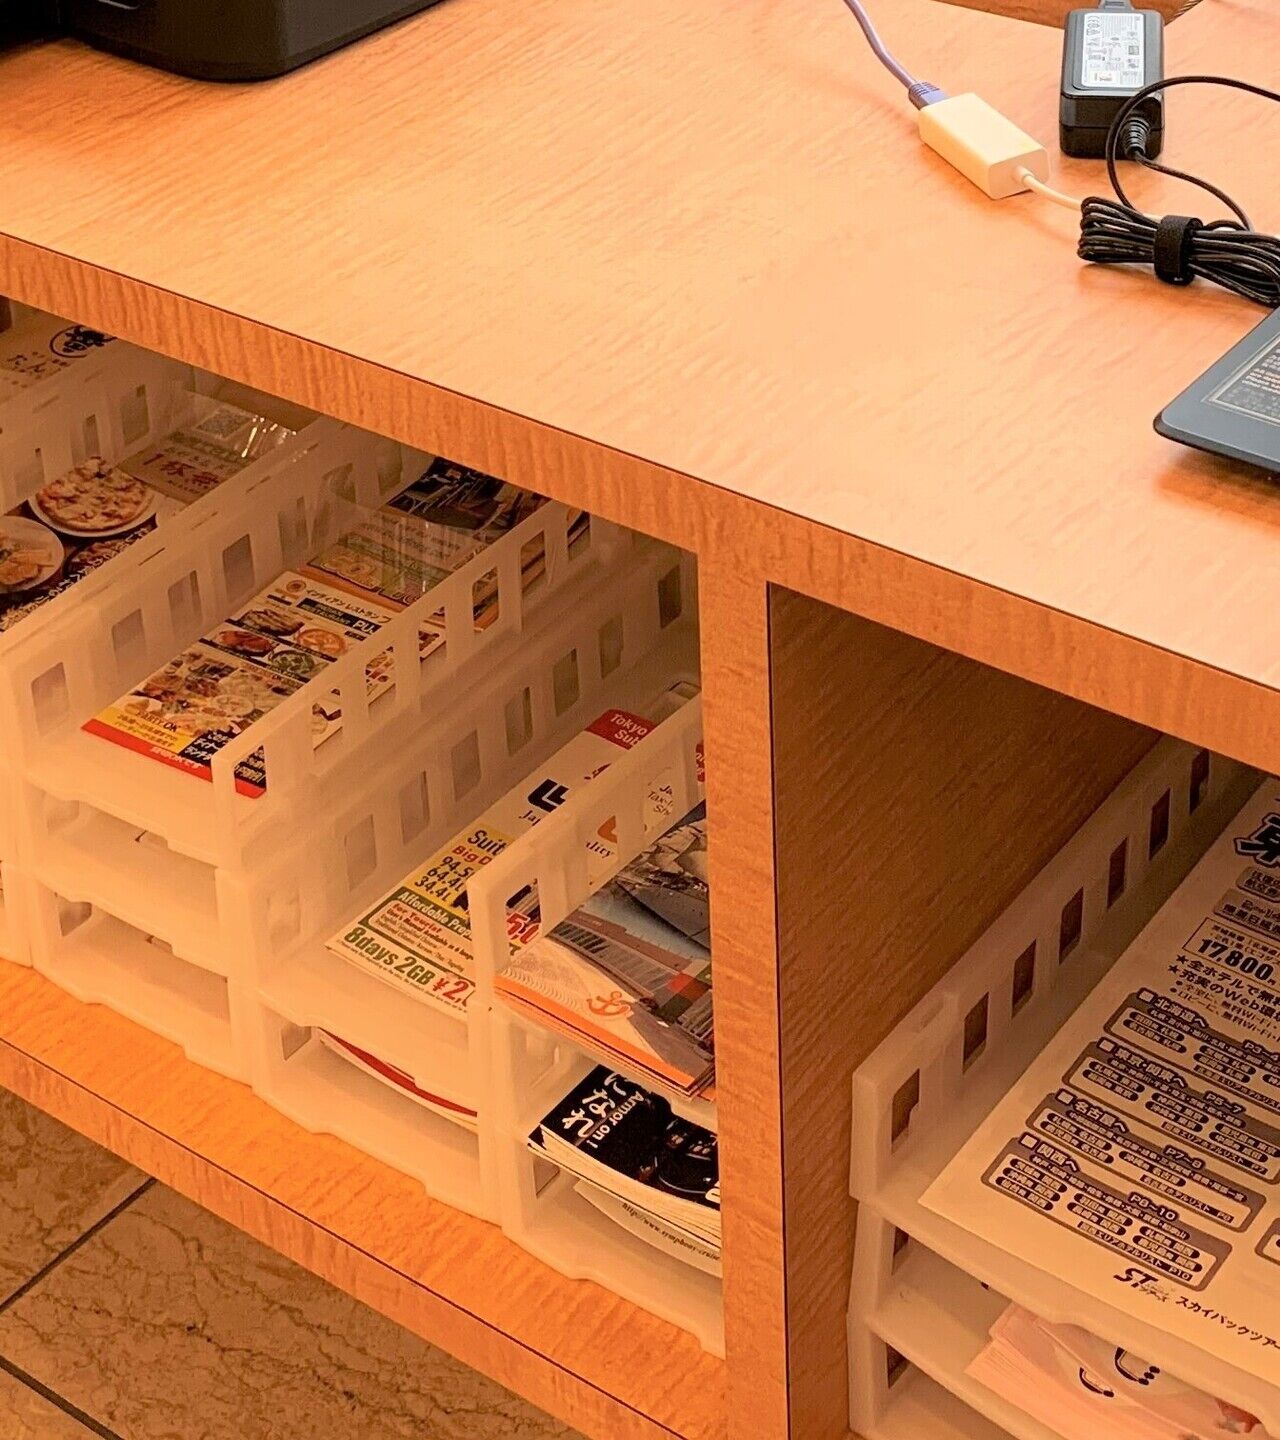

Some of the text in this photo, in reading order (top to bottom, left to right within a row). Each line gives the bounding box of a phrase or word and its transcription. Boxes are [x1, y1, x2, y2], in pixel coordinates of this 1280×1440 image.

[609, 713, 648, 736] Tokyo
[452, 845, 479, 862] Big
[398, 891, 450, 927] Affordable
[408, 908, 443, 934] Tourist
[343, 926, 399, 966] 8days
[393, 955, 436, 986] 2GB
[608, 1089, 646, 1127] Armor
[1071, 1098, 1132, 1134] 名古屋へ
[591, 1125, 611, 1141] on
[1034, 1141, 1084, 1173] 関西へ
